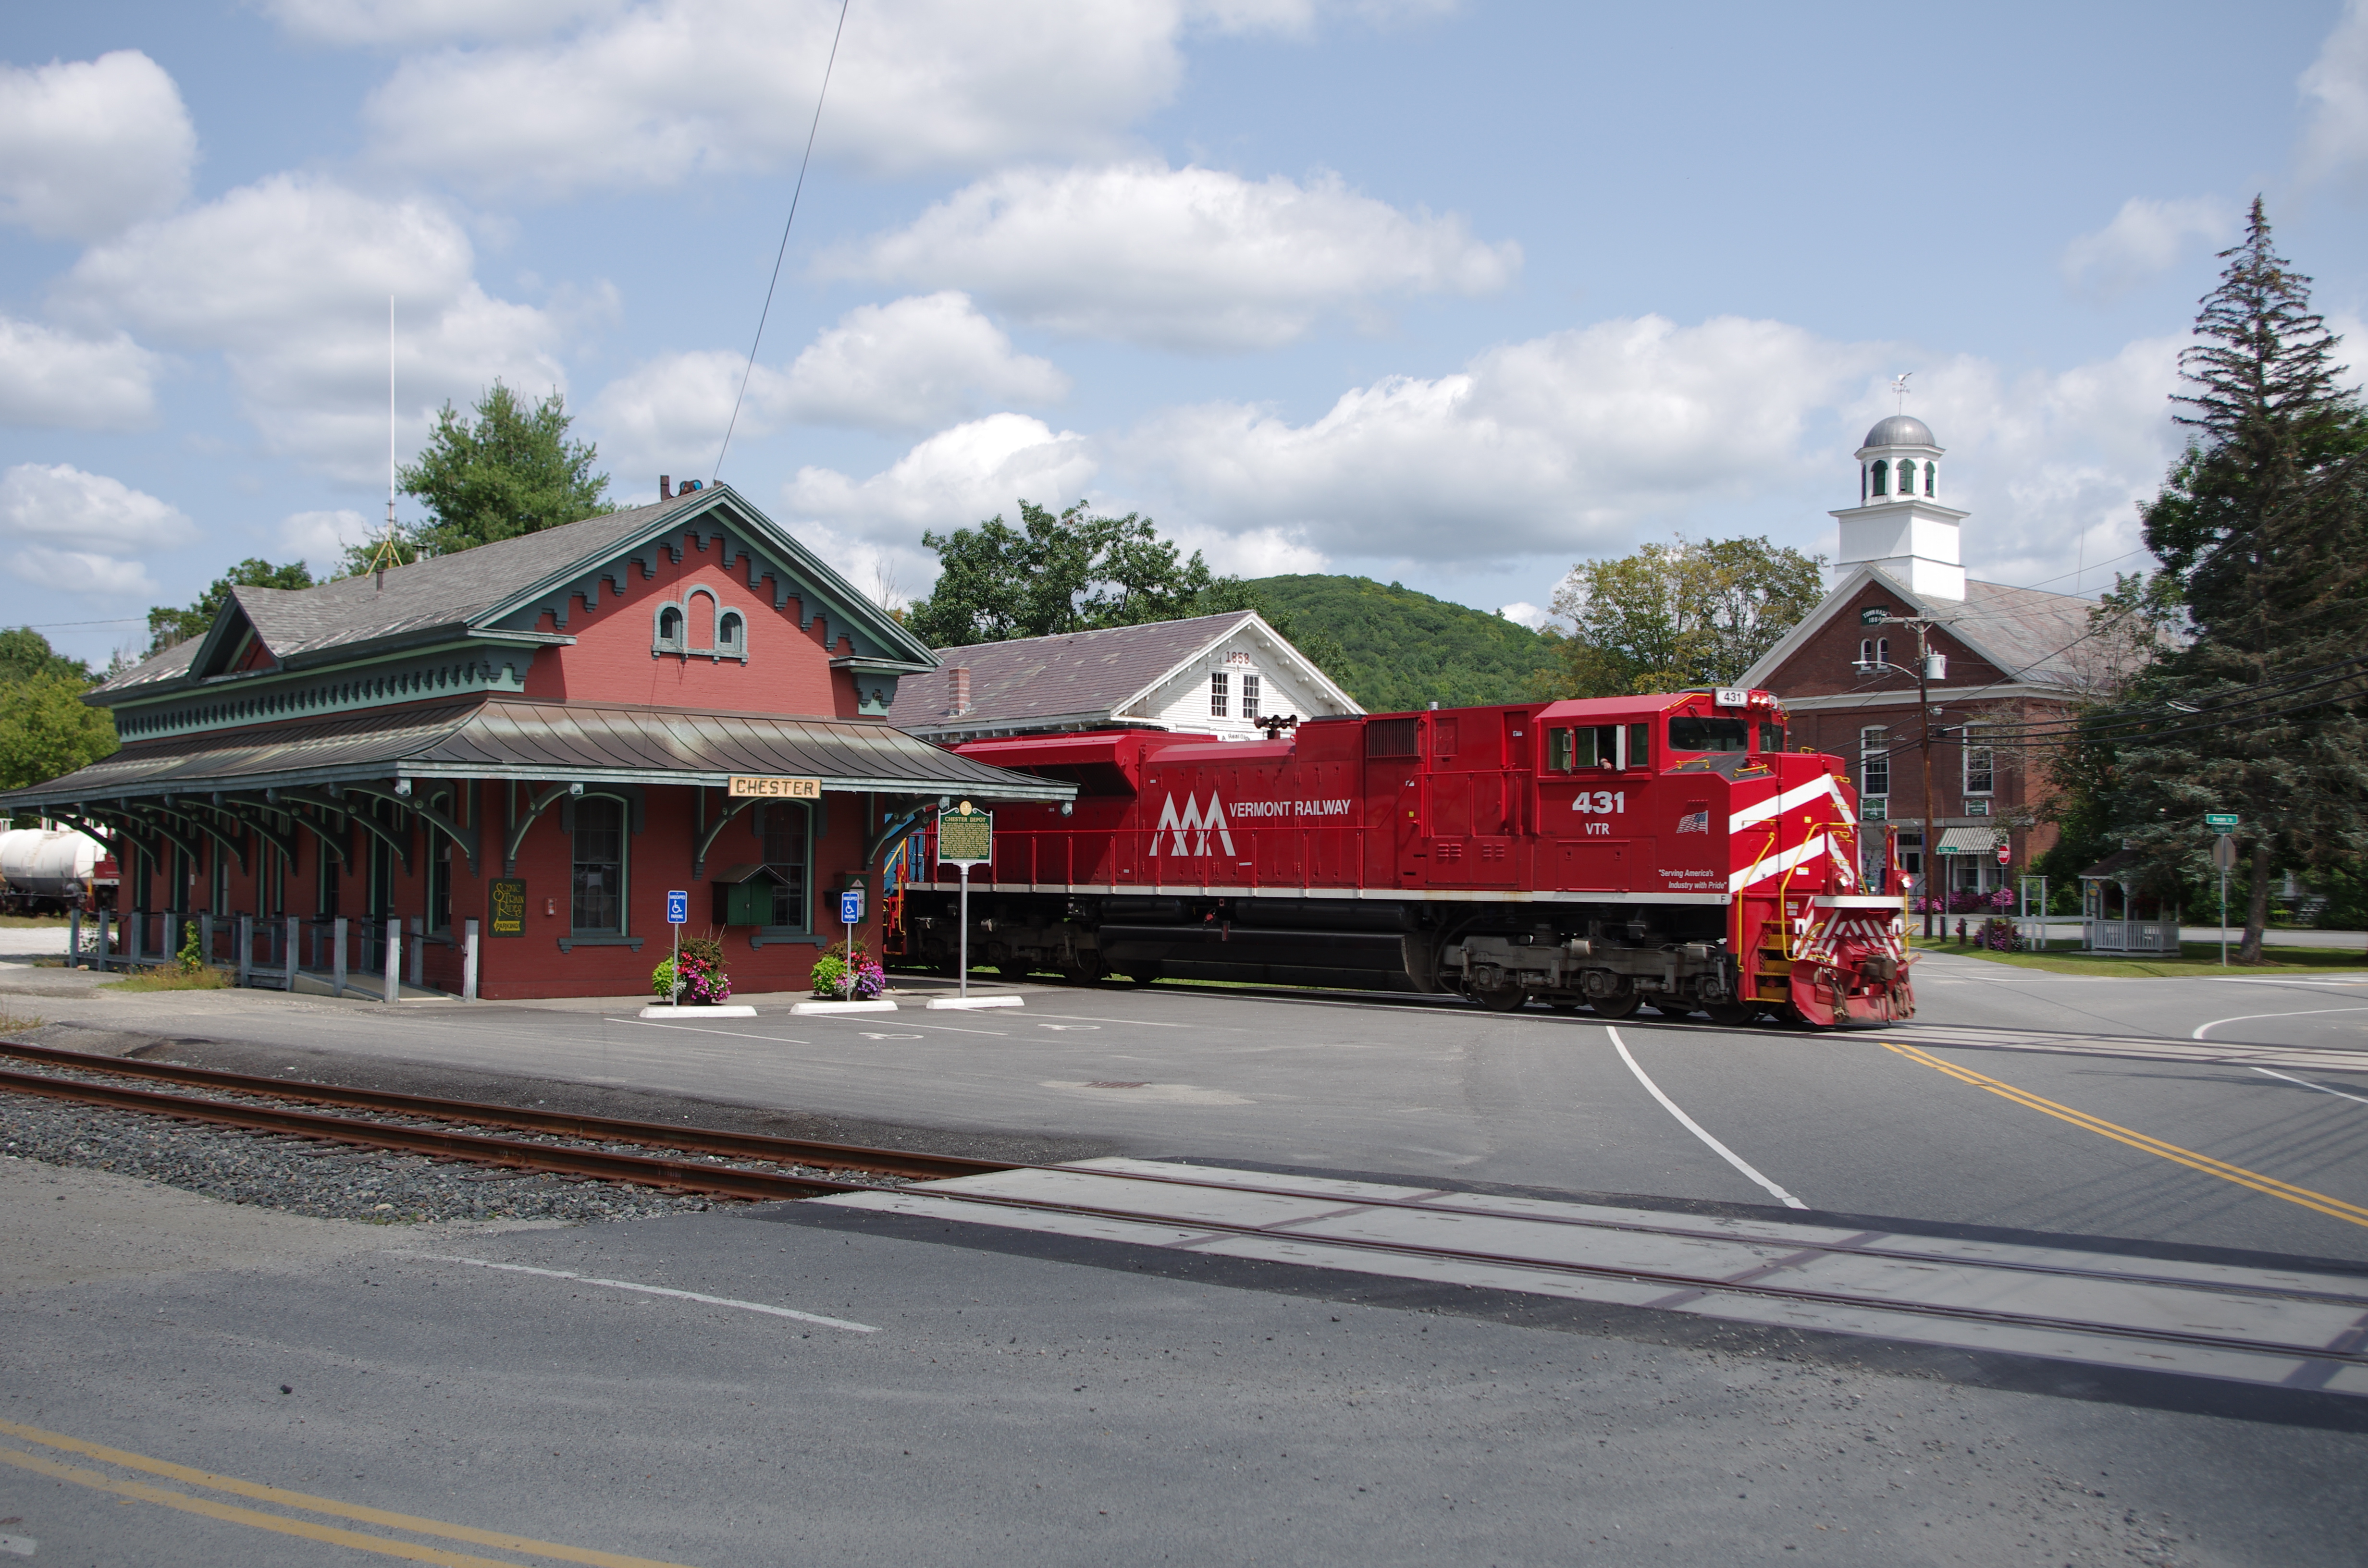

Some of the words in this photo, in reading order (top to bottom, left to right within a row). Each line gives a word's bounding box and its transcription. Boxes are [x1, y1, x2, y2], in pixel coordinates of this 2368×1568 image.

[1862, 610, 1875, 618] TOWN
[1226, 651, 1249, 664] 1858
[1724, 692, 1740, 702] 431
[737, 779, 814, 796] CHESTER
[1572, 791, 1624, 813] 431
[1229, 801, 1291, 817] VERMONT
[1295, 799, 1351, 816] RAILWAY
[1585, 823, 1610, 835] VTR
[1658, 869, 1683, 879] "Serving
[1668, 881, 1693, 891] Industry
[1708, 881, 1727, 889] Pride"
[1721, 895, 1726, 903] F
